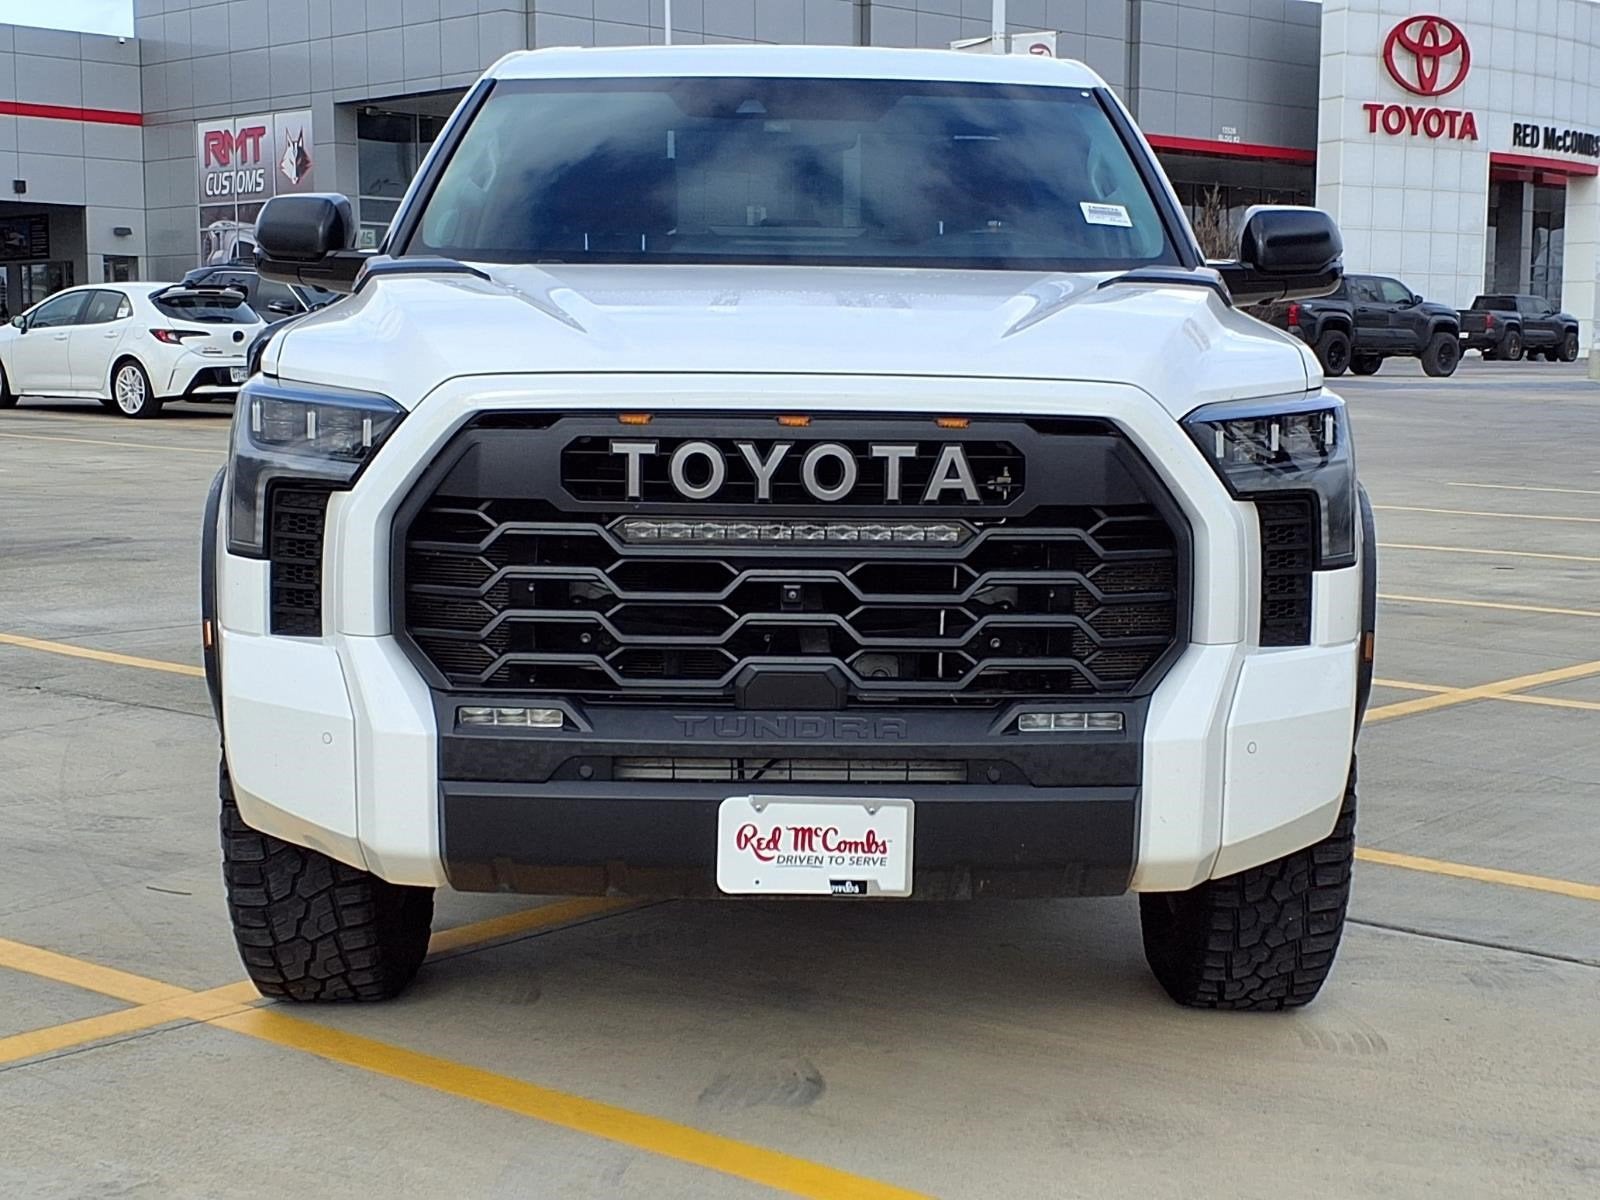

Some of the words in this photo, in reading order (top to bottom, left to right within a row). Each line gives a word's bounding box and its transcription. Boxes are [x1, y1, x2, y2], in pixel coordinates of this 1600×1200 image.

[1363, 103, 1478, 141] TOYOTA
[1513, 122, 1540, 148] RED
[1543, 127, 1600, 158] McCOMBS
[204, 126, 266, 168] RMT
[205, 169, 265, 196] CUSTOMS
[610, 442, 982, 502] TOYOTA
[673, 715, 908, 740] TUNDRA
[736, 823, 782, 862] Red
[785, 826, 888, 854] McCombs
[776, 855, 824, 866] DRIVEN
[828, 855, 846, 866] TO
[849, 855, 888, 867] SERVE
